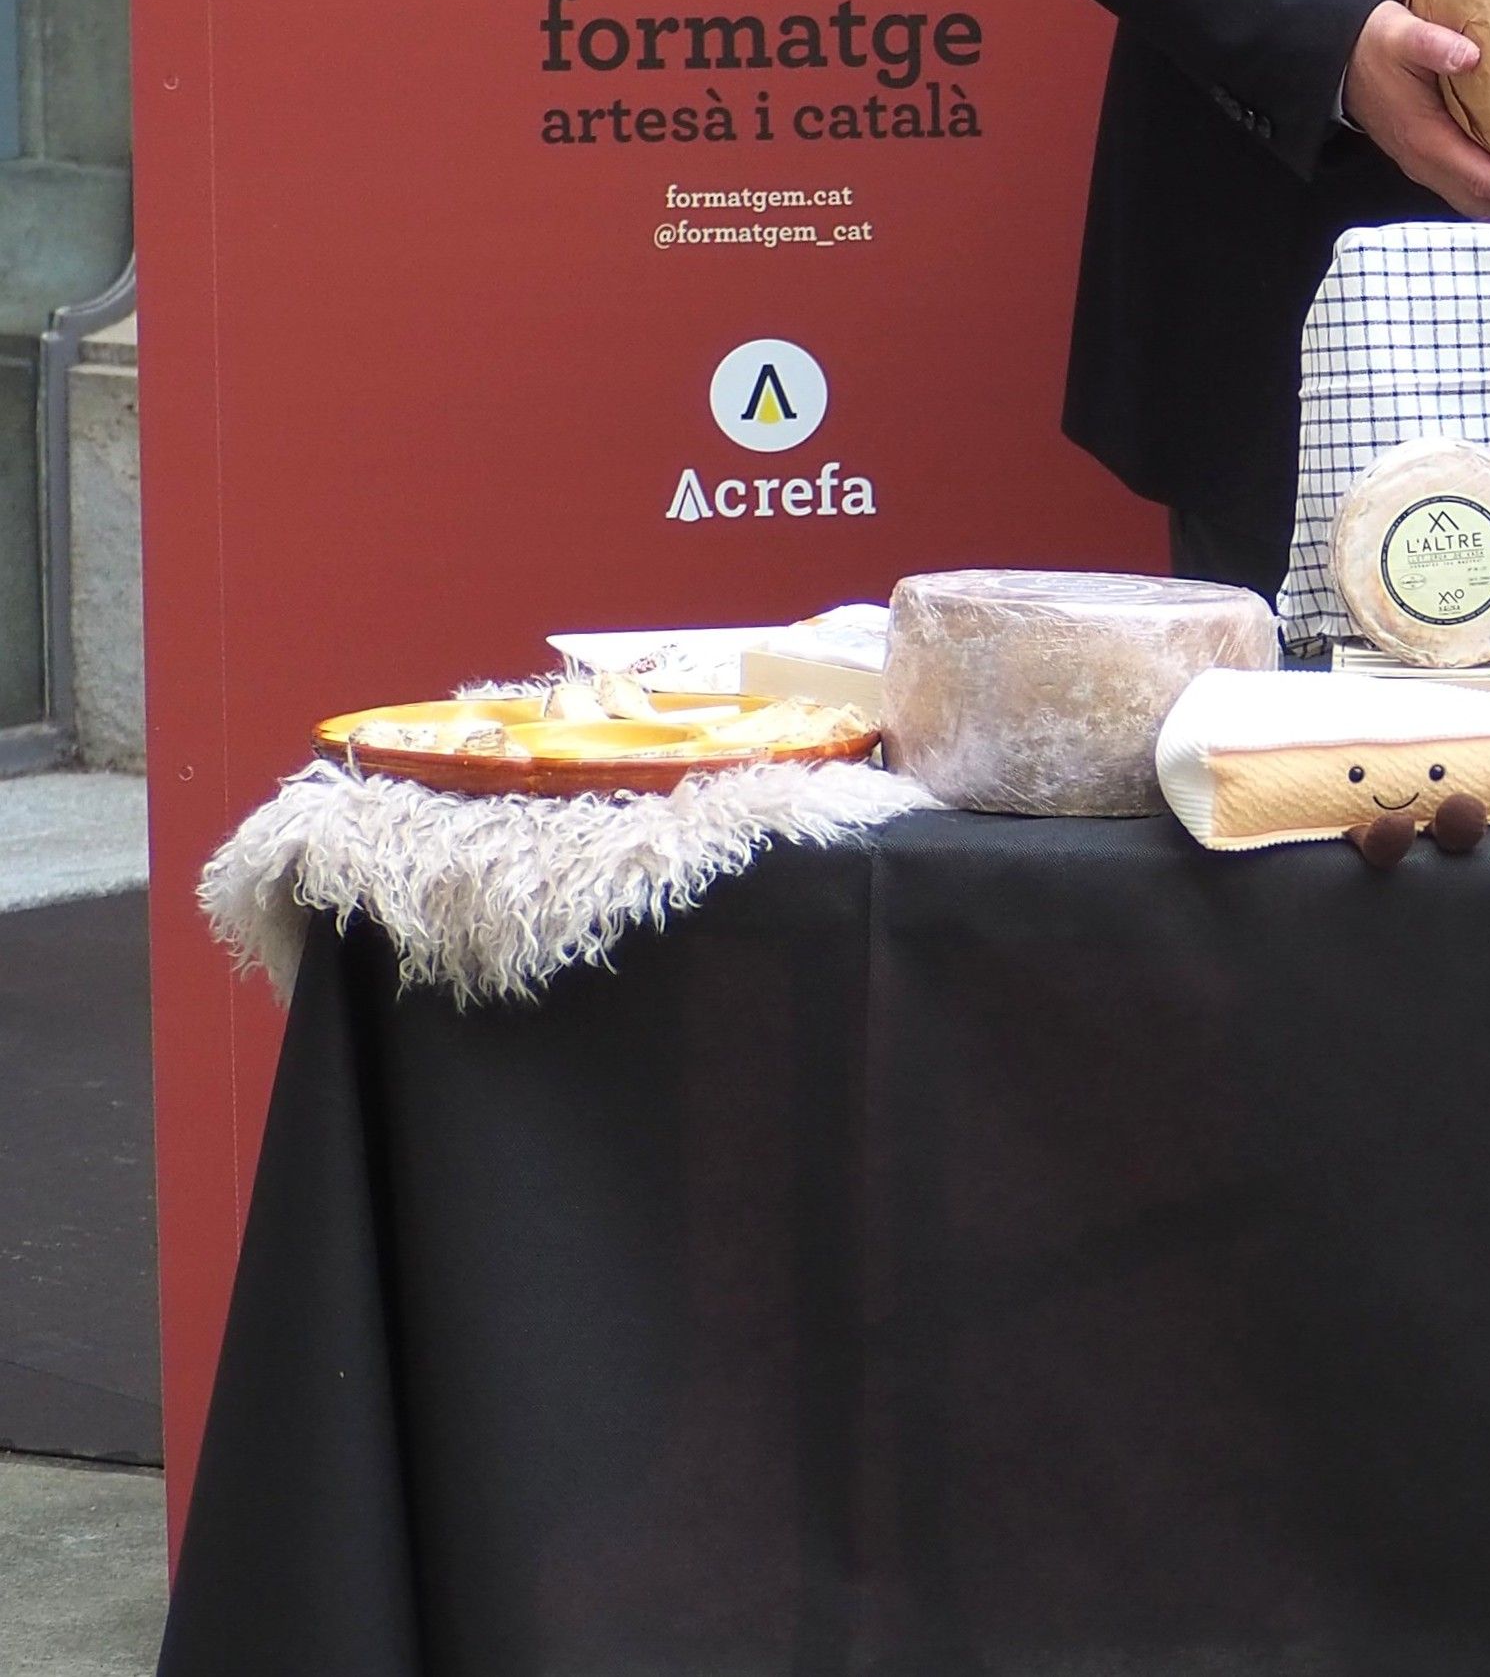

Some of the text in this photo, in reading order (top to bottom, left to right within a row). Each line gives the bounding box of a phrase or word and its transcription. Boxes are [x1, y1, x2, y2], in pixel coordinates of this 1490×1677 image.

[541, 82, 983, 144] artesà i català
[665, 184, 853, 213] formatgem.cat
[653, 219, 874, 249] @formatgem_cat
[666, 461, 876, 522] Acrefa
[1406, 532, 1483, 554] L'ALTRE
